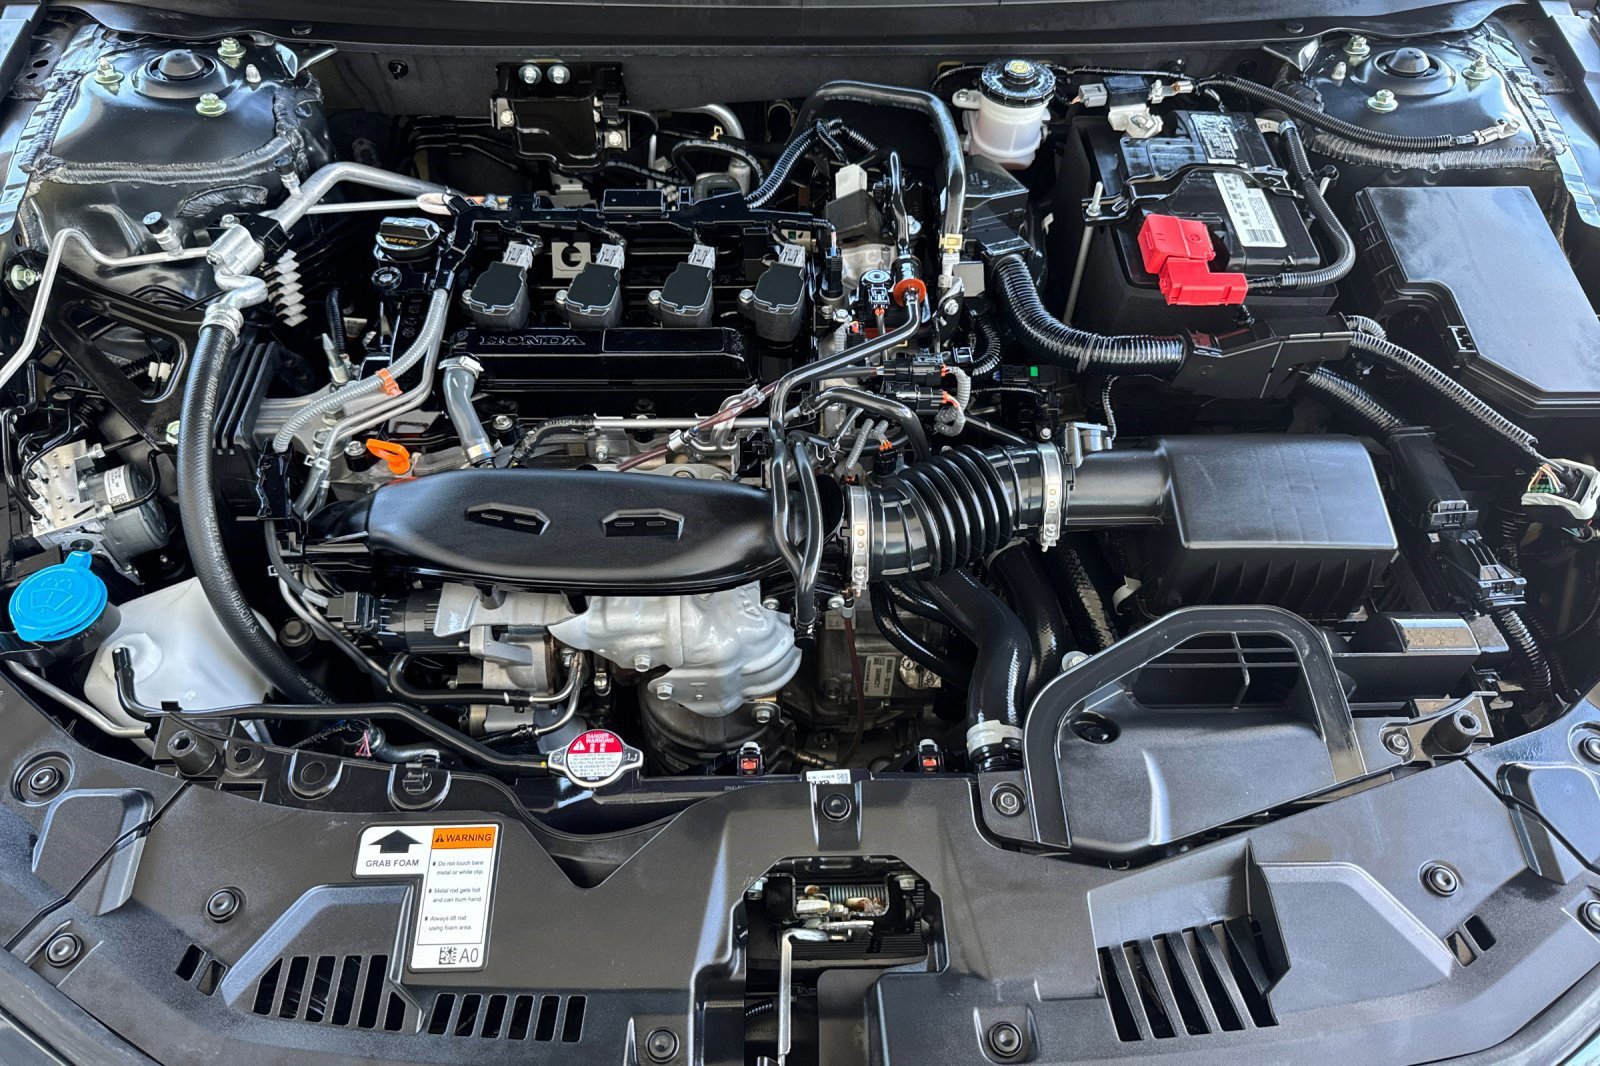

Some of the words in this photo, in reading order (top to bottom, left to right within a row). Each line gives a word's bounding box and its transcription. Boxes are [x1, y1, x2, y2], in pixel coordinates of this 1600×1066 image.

[479, 335, 586, 346] HONDA
[446, 833, 492, 842] WARNING
[366, 859, 391, 867] GRAB
[394, 859, 420, 867] FOAM
[459, 947, 479, 963] A0
